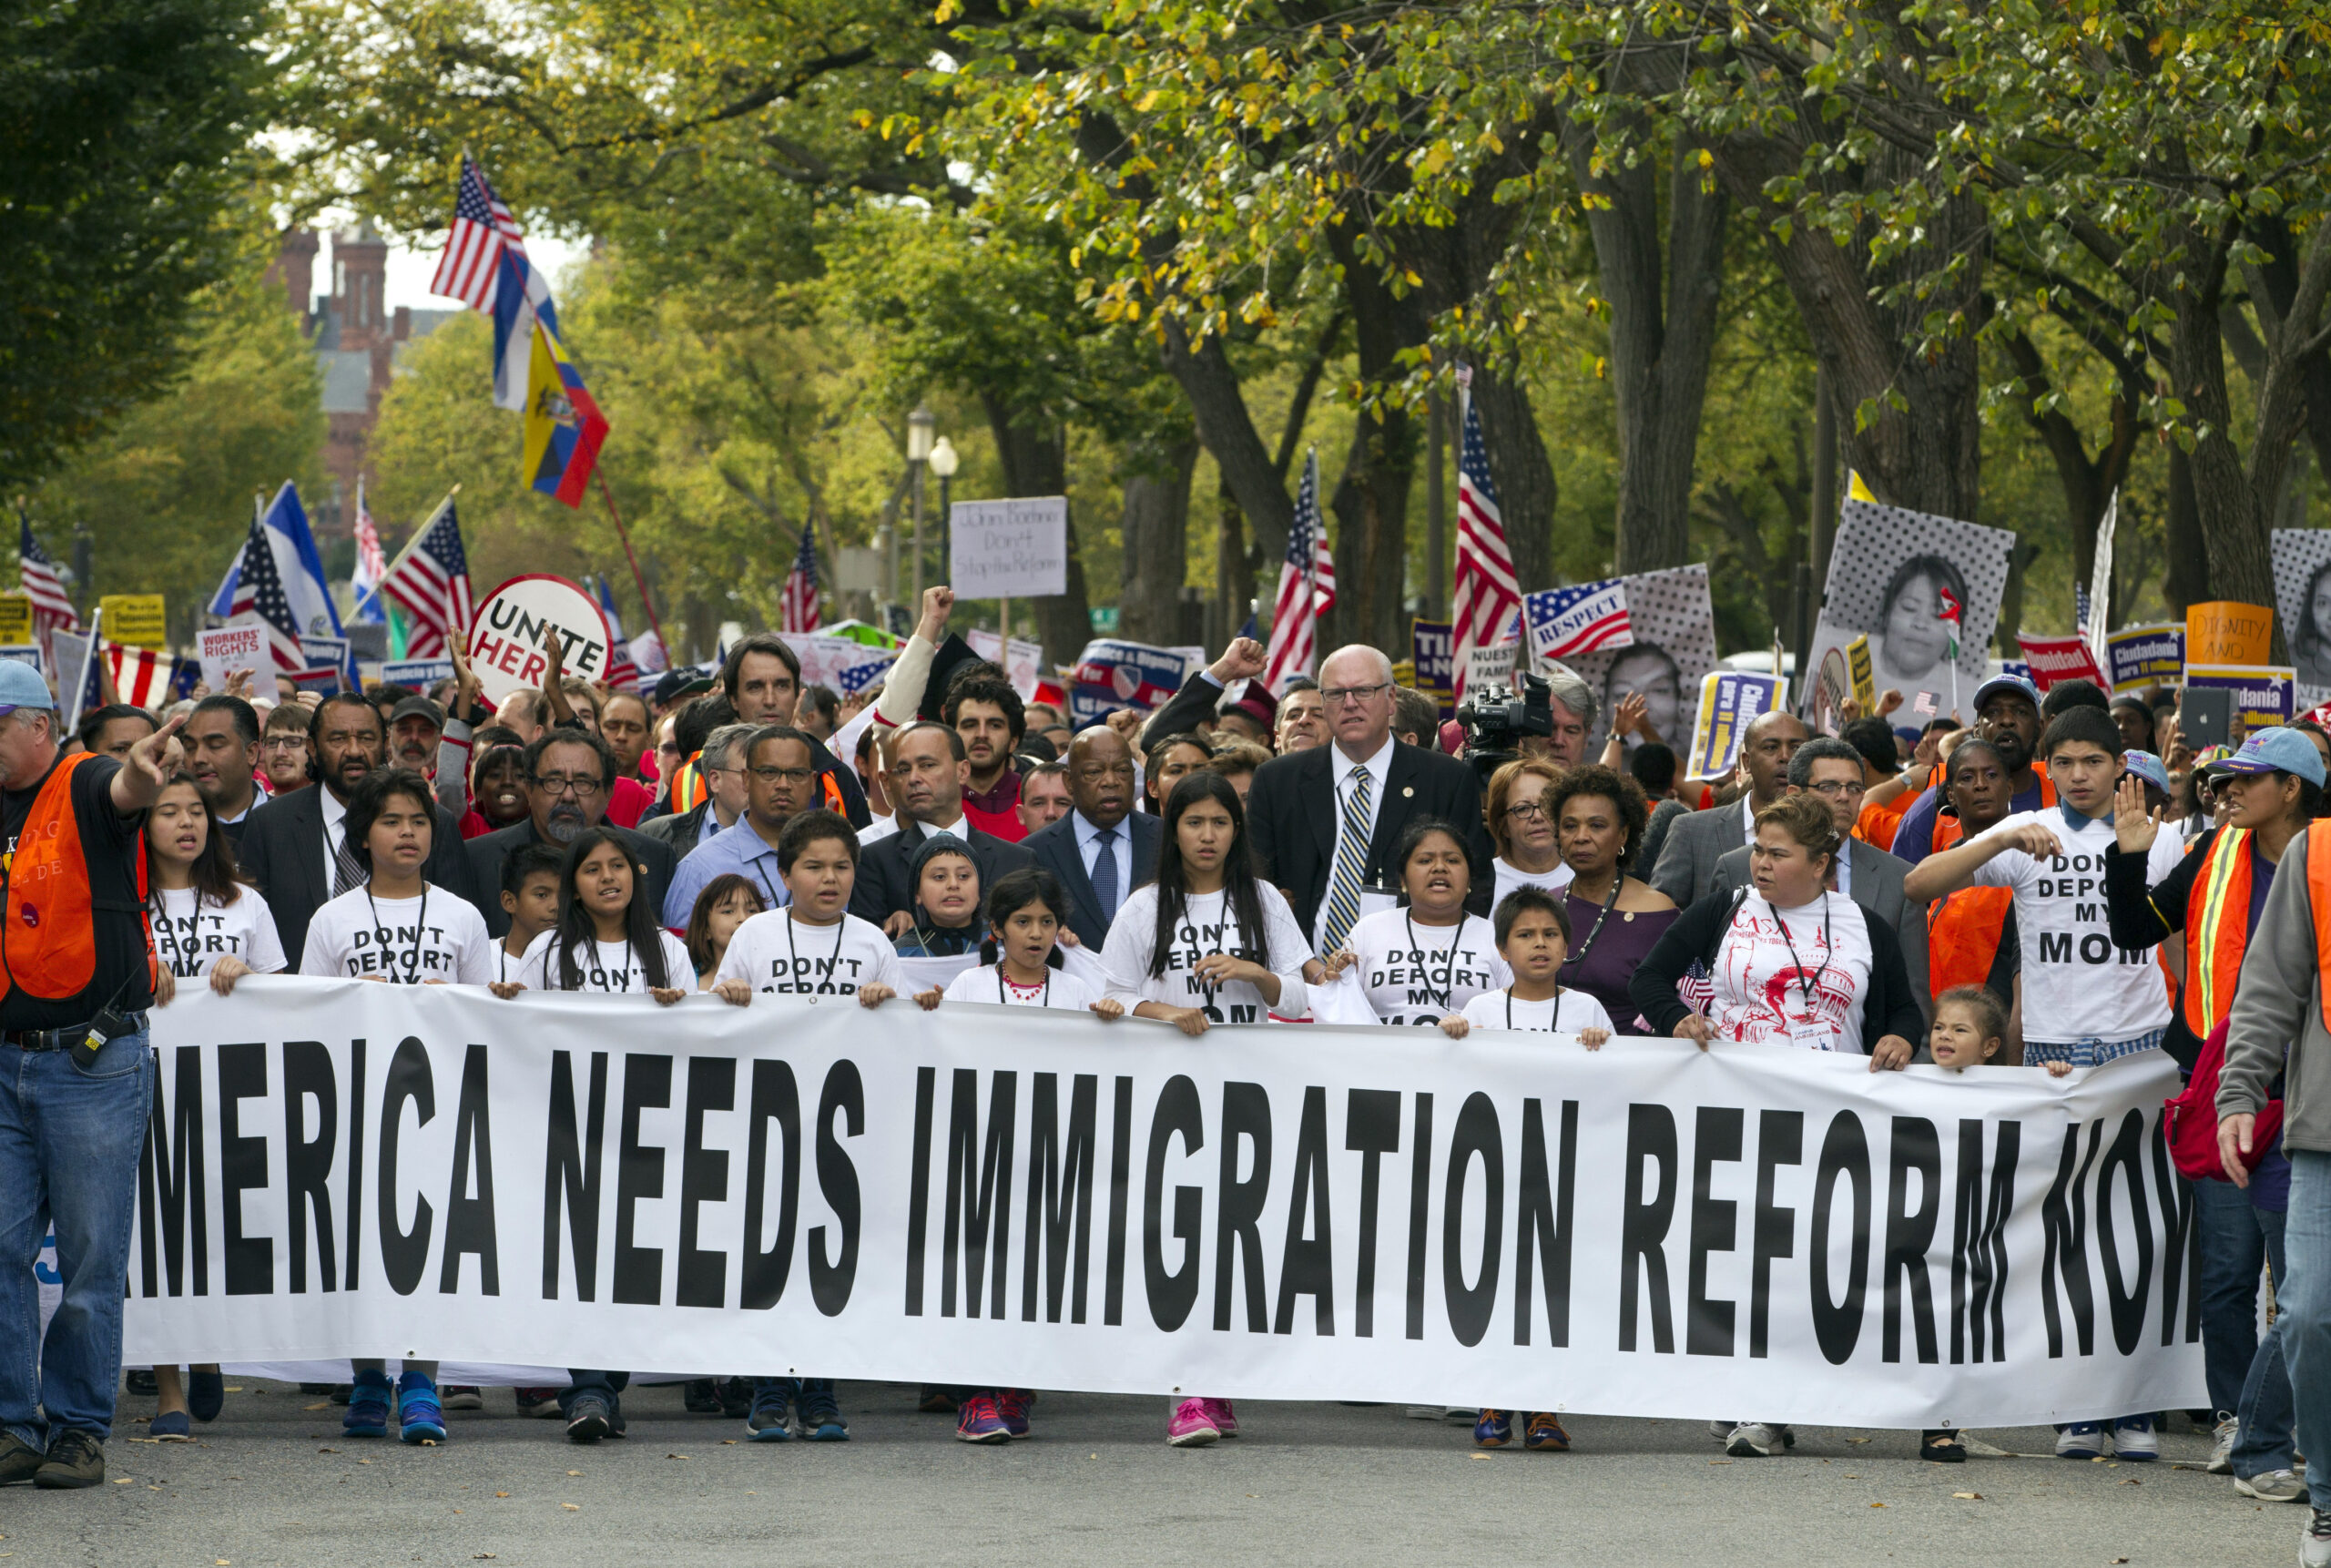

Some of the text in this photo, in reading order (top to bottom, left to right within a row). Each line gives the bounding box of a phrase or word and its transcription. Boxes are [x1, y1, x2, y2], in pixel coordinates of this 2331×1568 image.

[1538, 594, 1618, 645] RESPECT
[2193, 614, 2266, 642] DIGNITY
[203, 628, 260, 646] WORKERS'
[490, 598, 605, 672] UNITE
[1415, 631, 1452, 657] TI
[205, 641, 260, 657] RIGHTS
[473, 630, 571, 687] HER
[1471, 648, 1514, 663] NUEST
[2024, 647, 2089, 673] Dignidad
[2115, 640, 2179, 665] Ciudadania
[2204, 641, 2244, 660] AND
[2117, 665, 2139, 681] para
[2244, 710, 2285, 726] illones
[2052, 854, 2107, 872] DON
[154, 915, 225, 933] ON'T
[1733, 909, 1794, 941] CASA
[153, 934, 240, 954] PORT
[353, 925, 444, 950] DON'T
[2041, 932, 2148, 965] MOM
[346, 950, 453, 977] DEPORT
[771, 957, 862, 978] DON'T
[1387, 950, 1477, 965] DON'T
[1371, 968, 1491, 990] DEPORT
[1408, 989, 1452, 1007] MY
[126, 1035, 501, 1297] MERICA
[542, 1050, 865, 1318] NEEDS
[905, 1066, 1579, 1349] IMMIGRATION
[1619, 1102, 2021, 1365] REFORM
